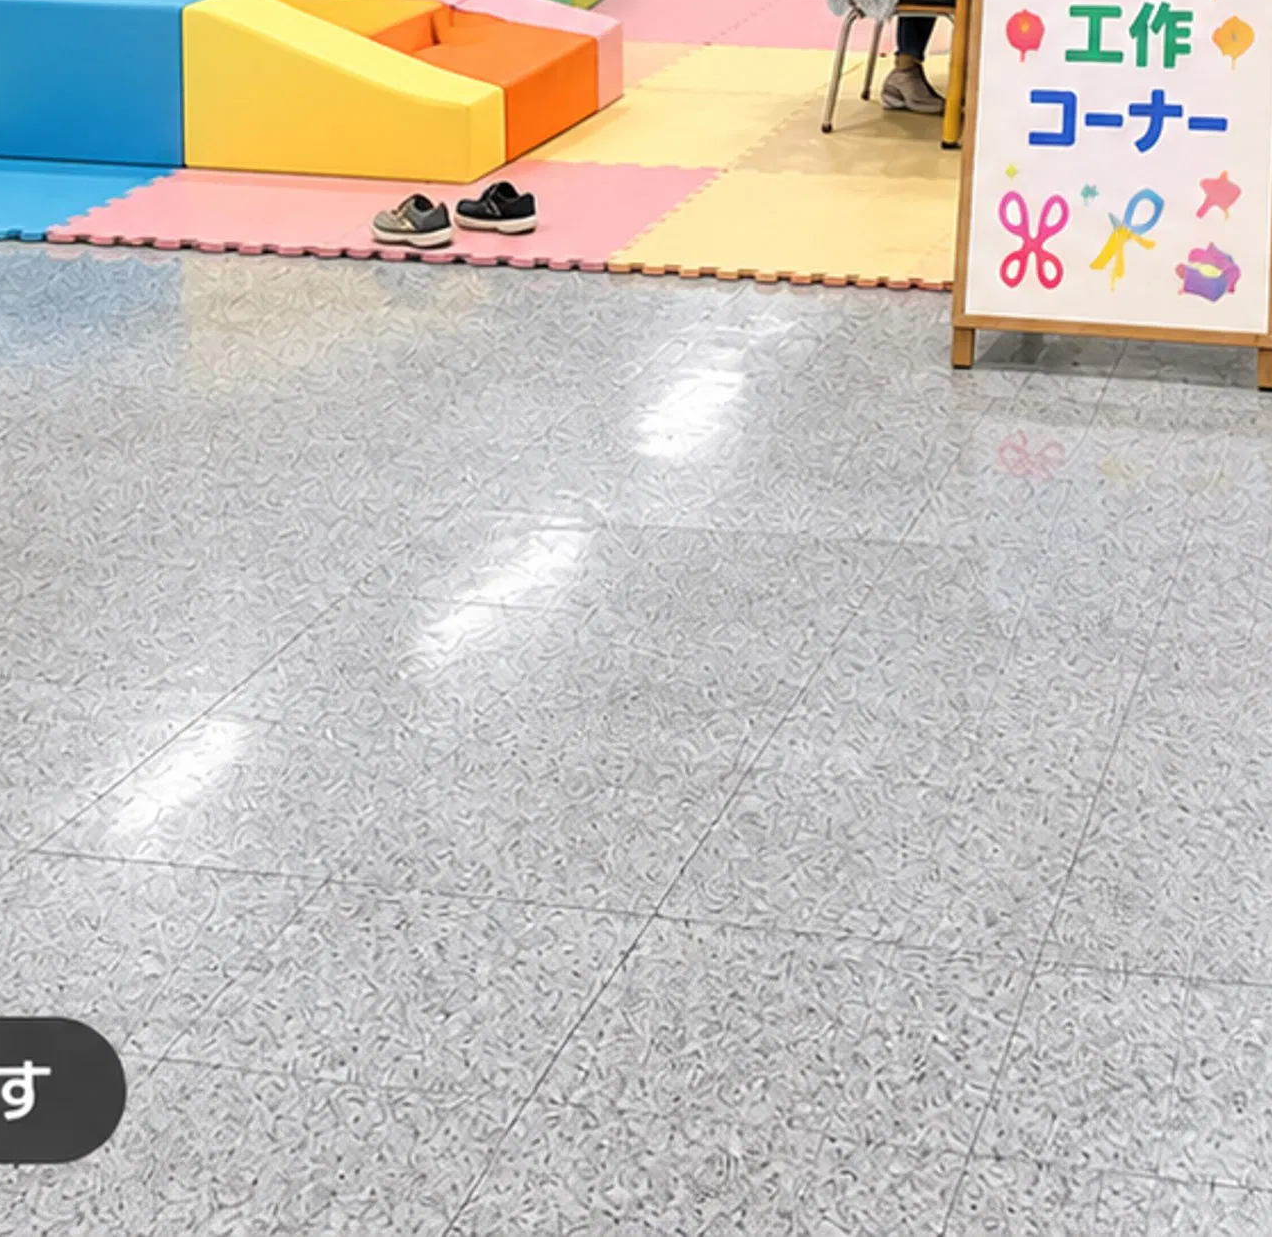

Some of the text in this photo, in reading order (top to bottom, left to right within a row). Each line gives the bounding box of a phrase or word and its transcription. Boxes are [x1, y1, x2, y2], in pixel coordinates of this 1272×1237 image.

[1065, 2, 1194, 69] 工作
[1028, 89, 1228, 153] コーナー
